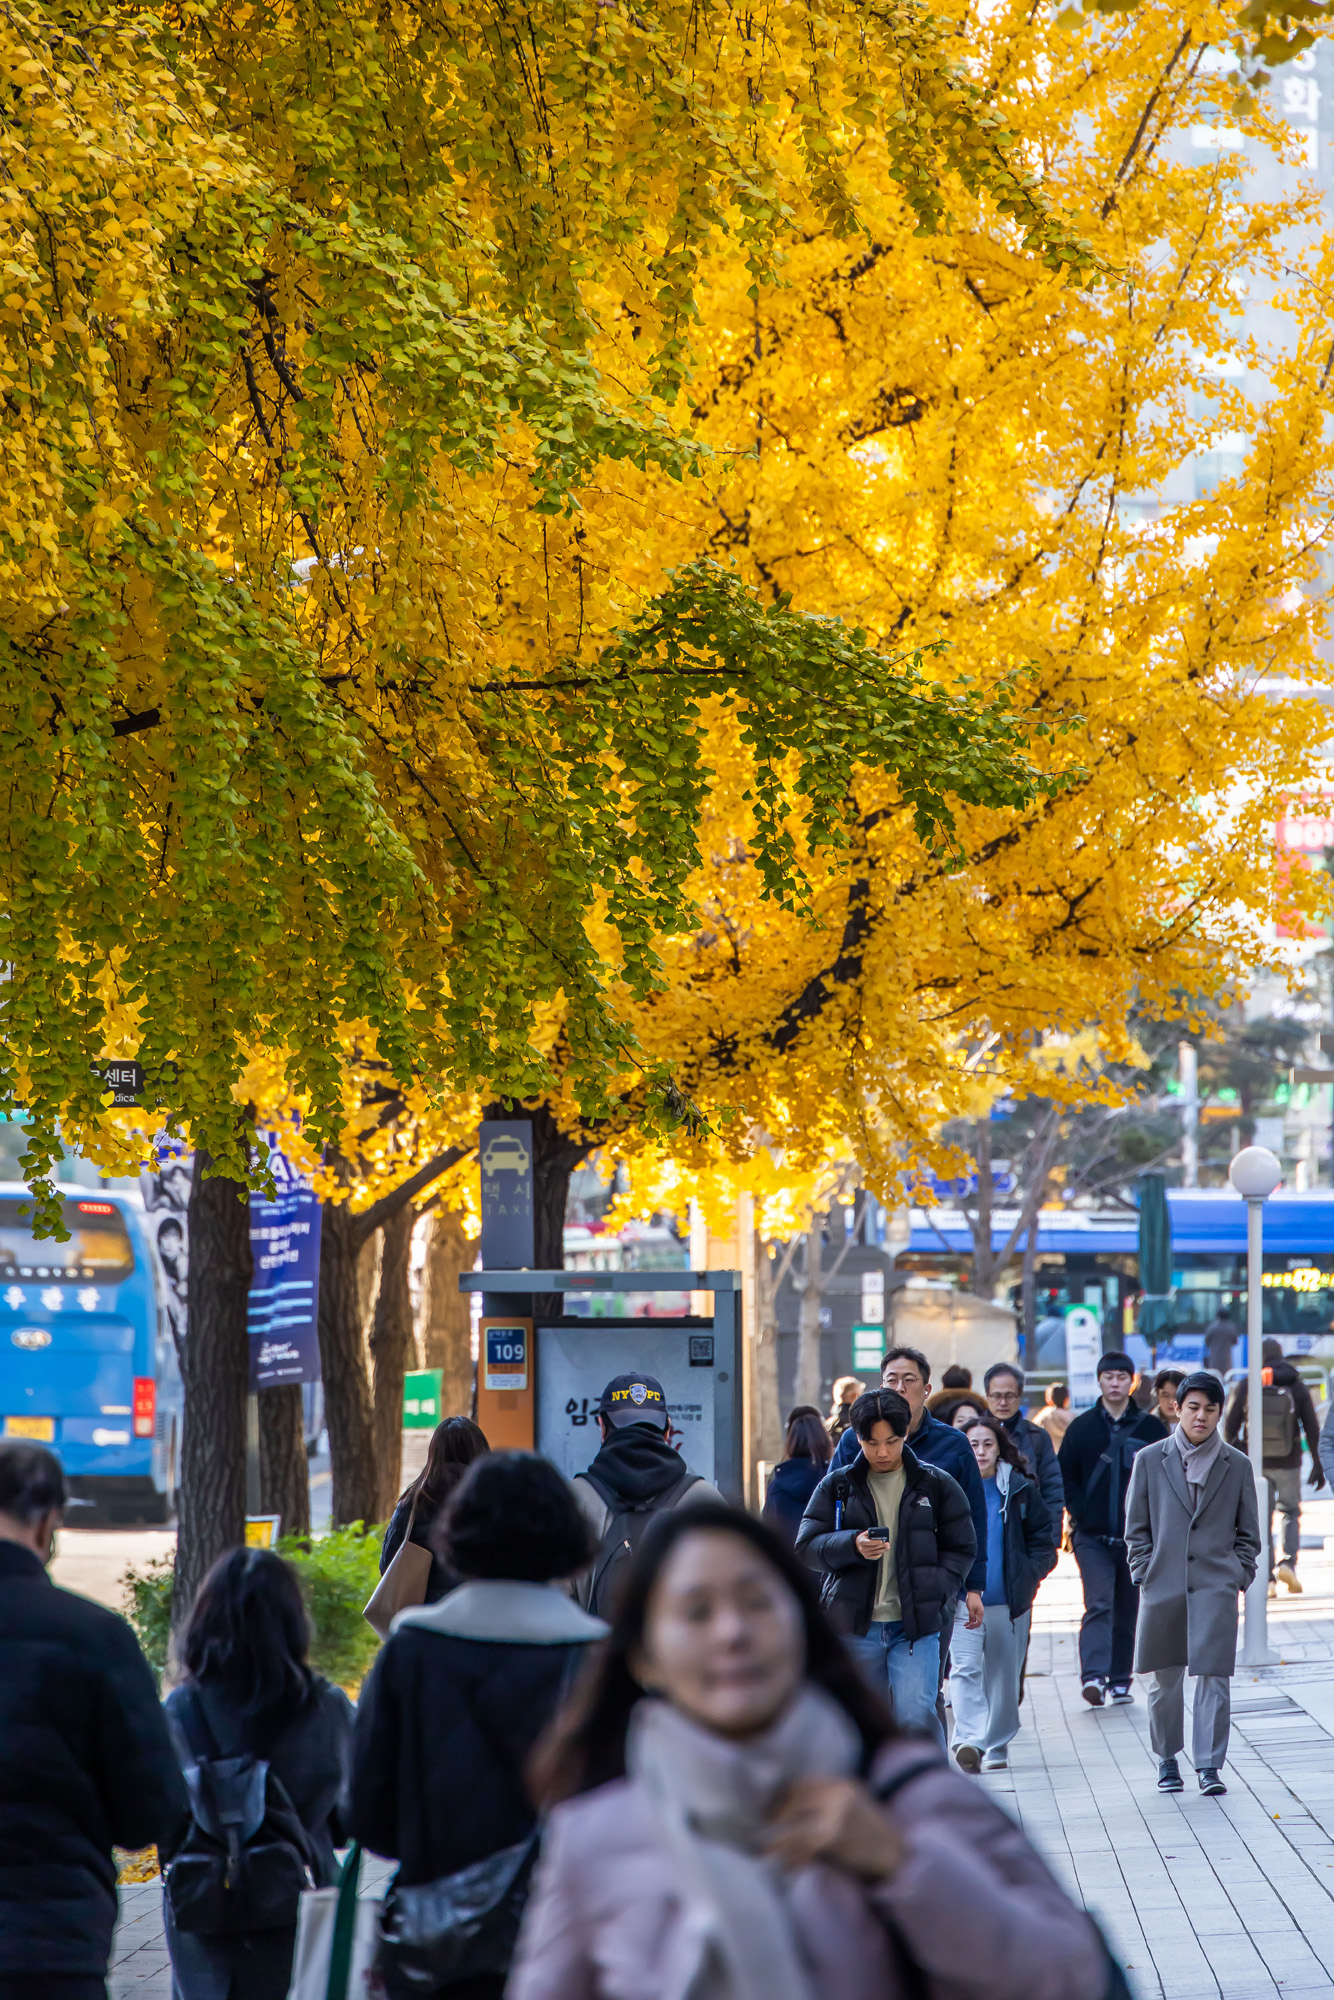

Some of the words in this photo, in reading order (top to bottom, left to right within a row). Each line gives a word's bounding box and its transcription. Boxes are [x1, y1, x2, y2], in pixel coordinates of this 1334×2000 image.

[483, 1181, 530, 1200] 택시
[485, 1204, 530, 1216] TAXI
[495, 1344, 524, 1360] 109
